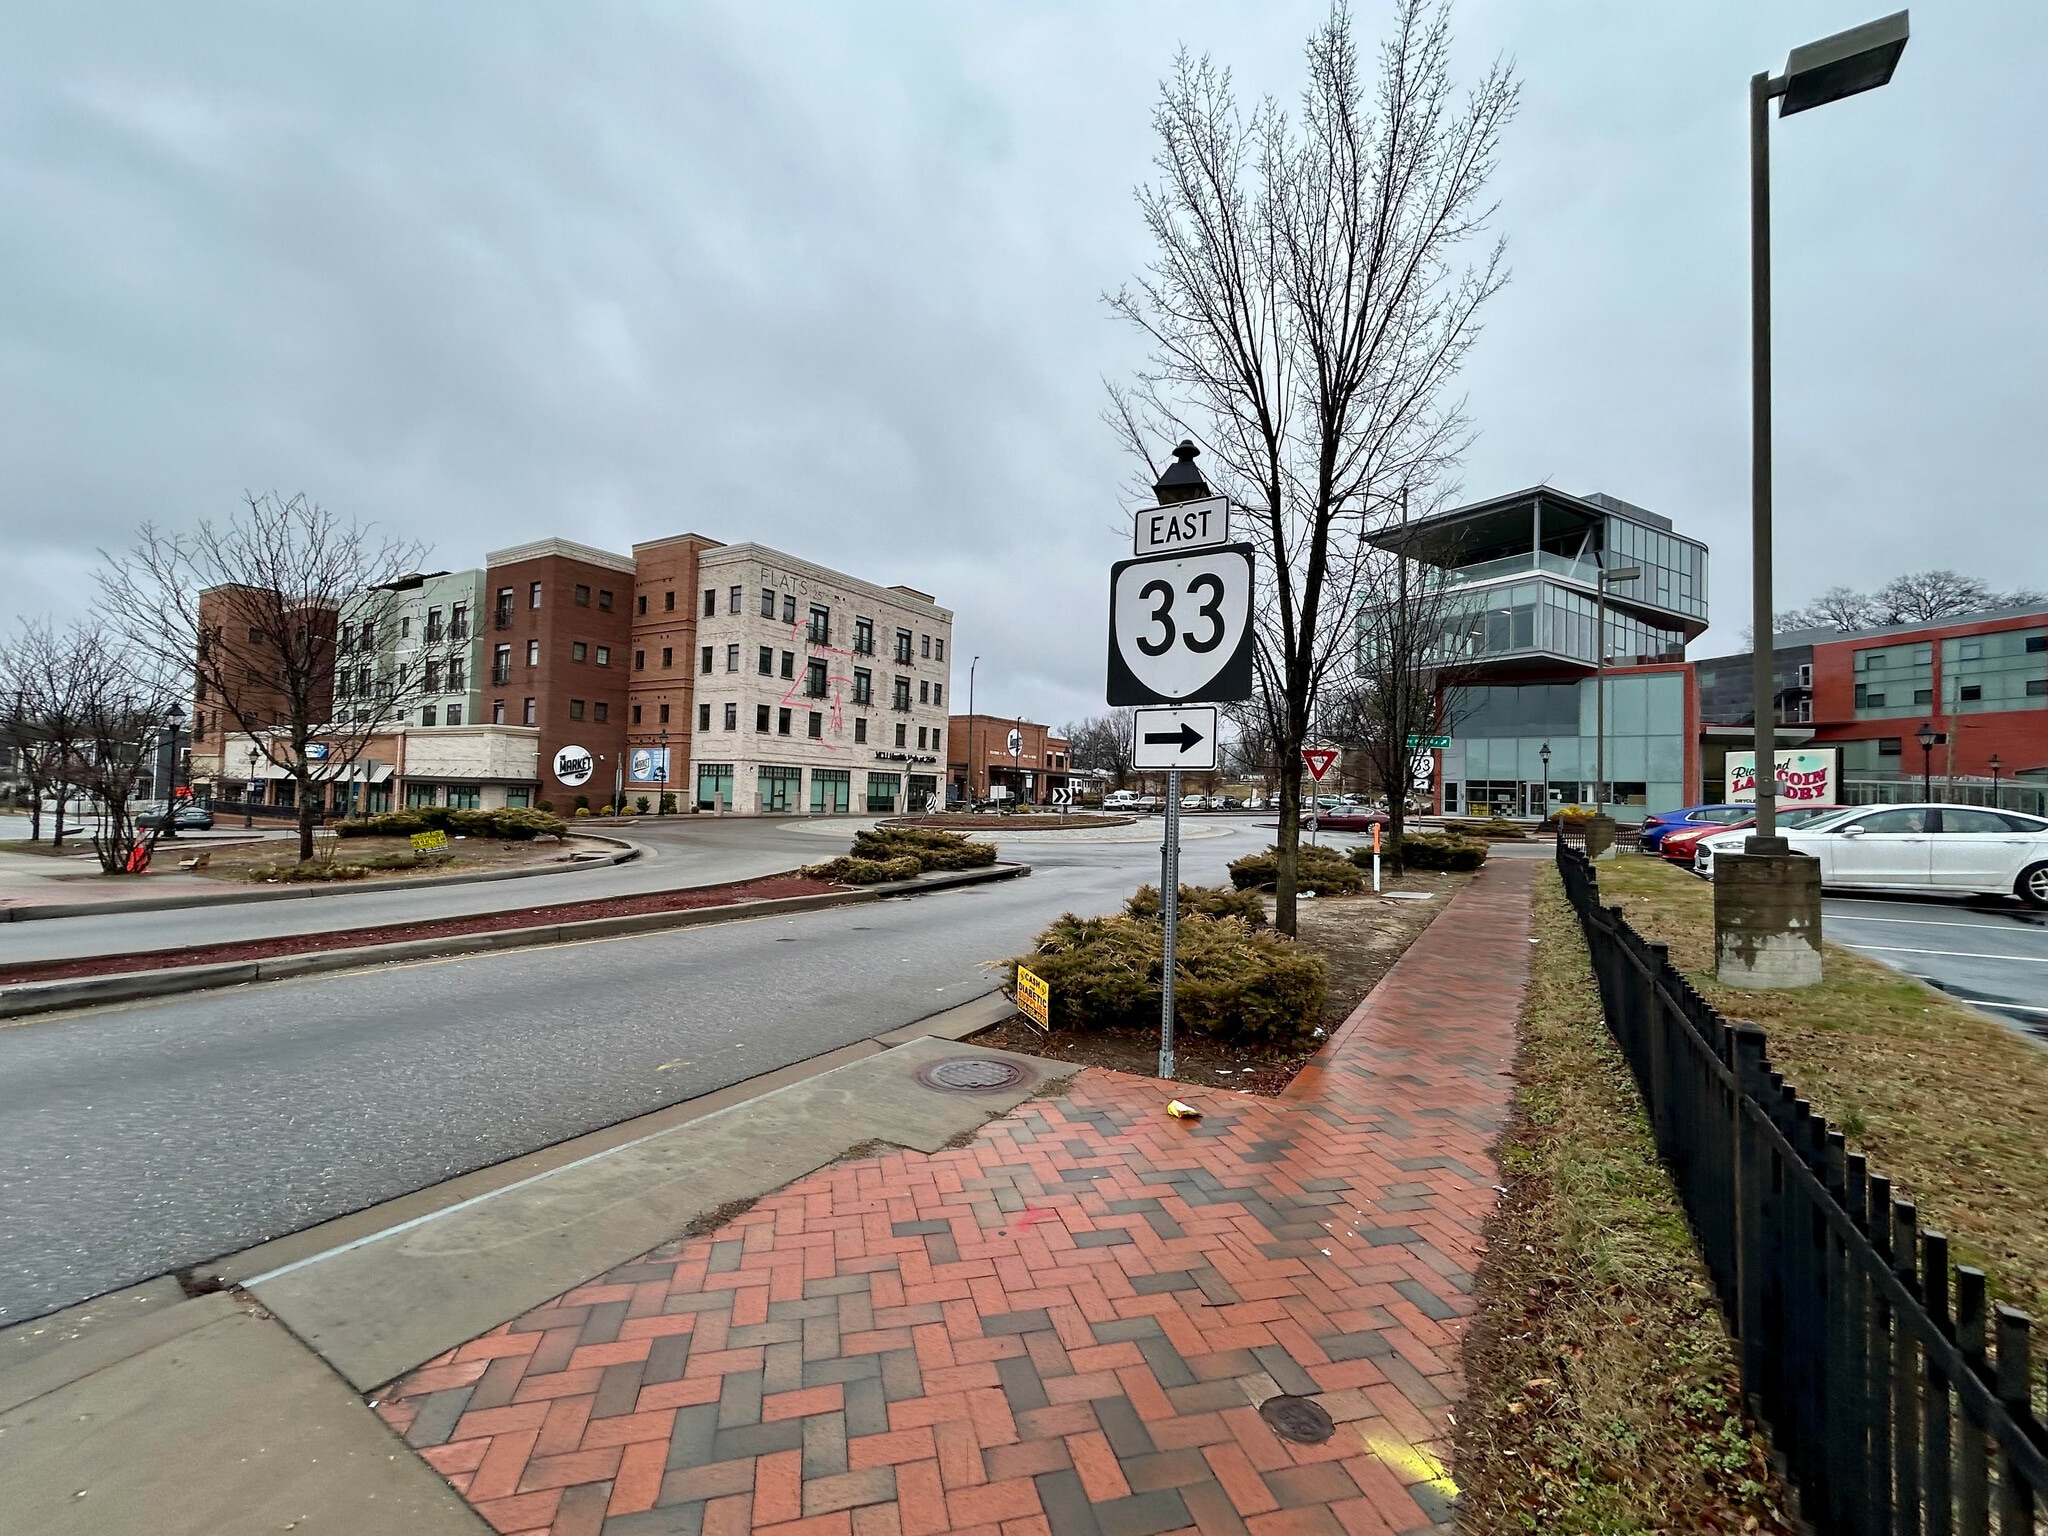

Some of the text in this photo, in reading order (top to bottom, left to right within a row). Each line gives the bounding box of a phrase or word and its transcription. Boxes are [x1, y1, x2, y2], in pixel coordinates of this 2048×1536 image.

[1150, 510, 1211, 545] EAST
[761, 567, 808, 596] FLATS
[1136, 572, 1225, 657] 33
[559, 756, 592, 773] MARKET
[1731, 758, 1791, 779] Ricnd
[1776, 767, 1828, 786] COIN
[1732, 776, 1828, 801] LADRY
[1025, 973, 1041, 989] CASH
[1019, 982, 1047, 1009] DIABETIC
